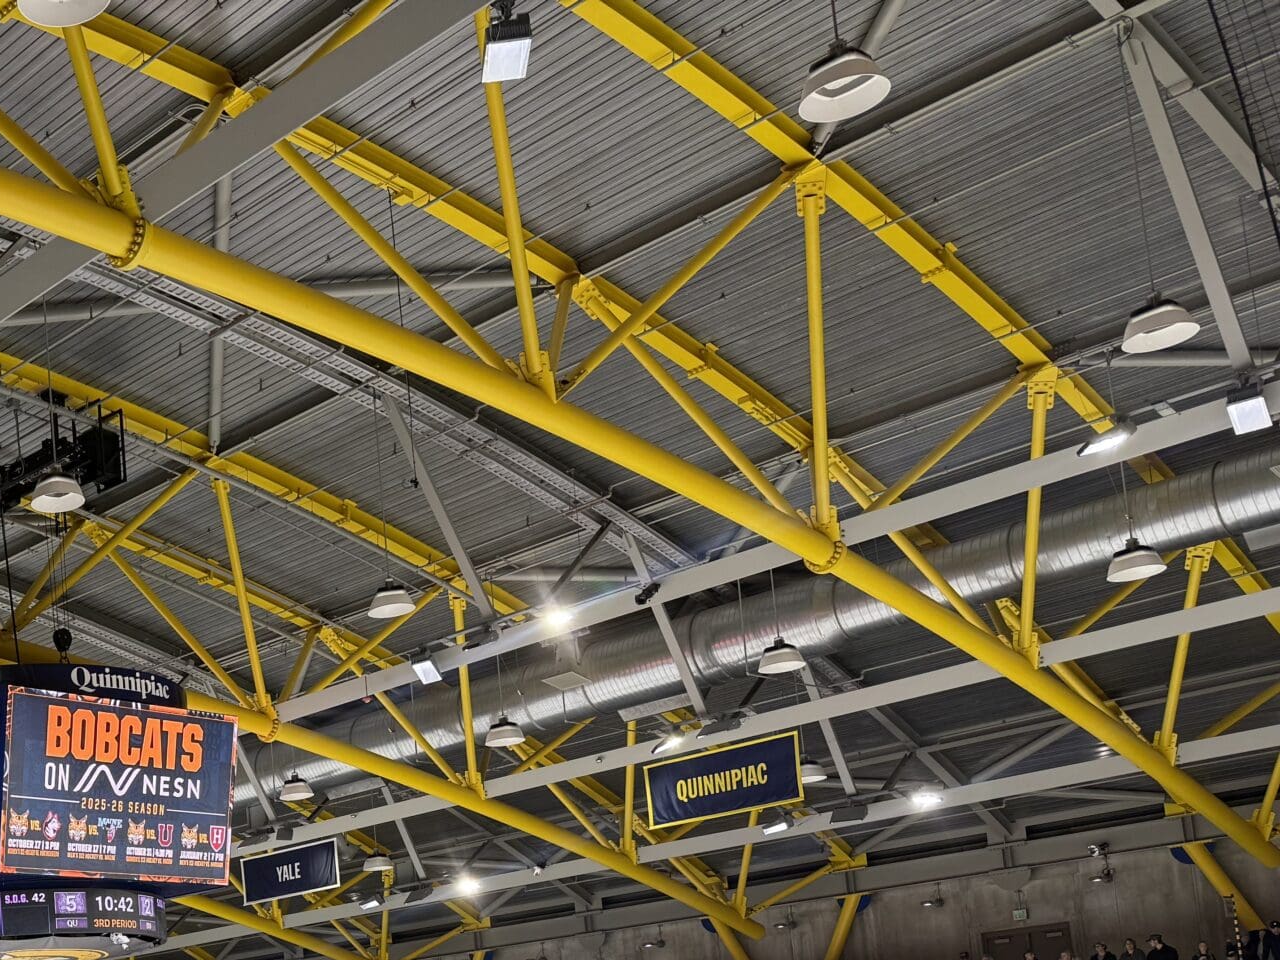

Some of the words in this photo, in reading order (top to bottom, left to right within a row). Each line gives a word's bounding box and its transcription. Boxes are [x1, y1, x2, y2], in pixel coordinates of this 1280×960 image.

[70, 666, 170, 699] Quinnipiac
[46, 704, 204, 772] BOBCATS
[44, 762, 69, 791] ON
[142, 774, 201, 800] NESN
[676, 762, 768, 803] QUINNIPIAC
[81, 797, 123, 812] 2025-26
[128, 801, 165, 816] SEASON
[276, 862, 301, 882] YALE
[4, 894, 29, 904] S.O.G.
[31, 893, 46, 903] 42
[66, 895, 77, 912] 5
[96, 896, 134, 913] 10:42
[144, 899, 151, 914] 2
[93, 919, 110, 928] 3RD
[111, 919, 136, 929] PERIOD
